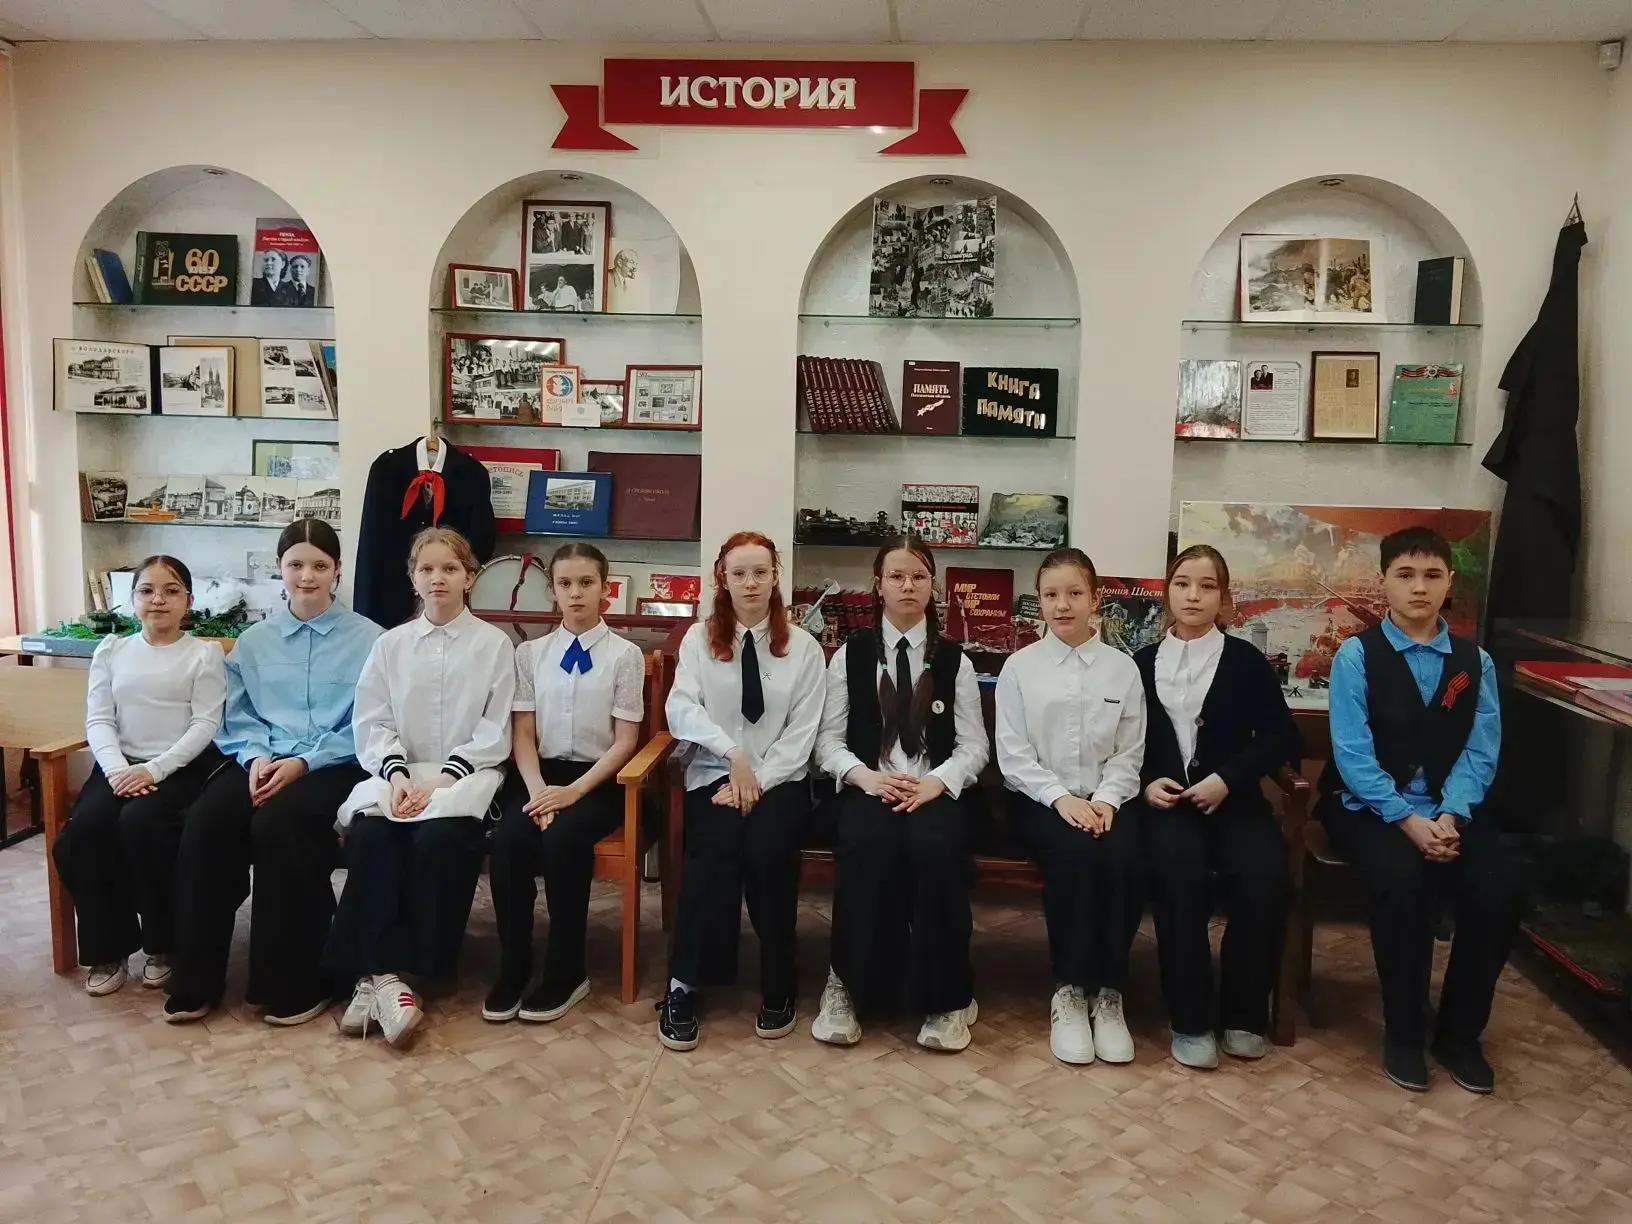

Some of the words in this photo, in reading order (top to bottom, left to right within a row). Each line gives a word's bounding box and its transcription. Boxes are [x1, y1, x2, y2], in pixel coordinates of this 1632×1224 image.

[659, 76, 857, 109] ИСТОРИЯ
[185, 248, 220, 273] 60
[175, 274, 229, 293] СССР
[913, 383, 949, 394] ПАМЯТЬ
[987, 371, 1041, 400] КНИГА
[976, 398, 1046, 430] ПАМЯТИ
[488, 466, 524, 477] ЕТОПИСЬ
[954, 582, 977, 593] МИР
[1131, 586, 1163, 597] Шост
[965, 593, 1000, 601] ОТСТОЯЛИ
[969, 608, 1007, 618] СОХРАНИМ
